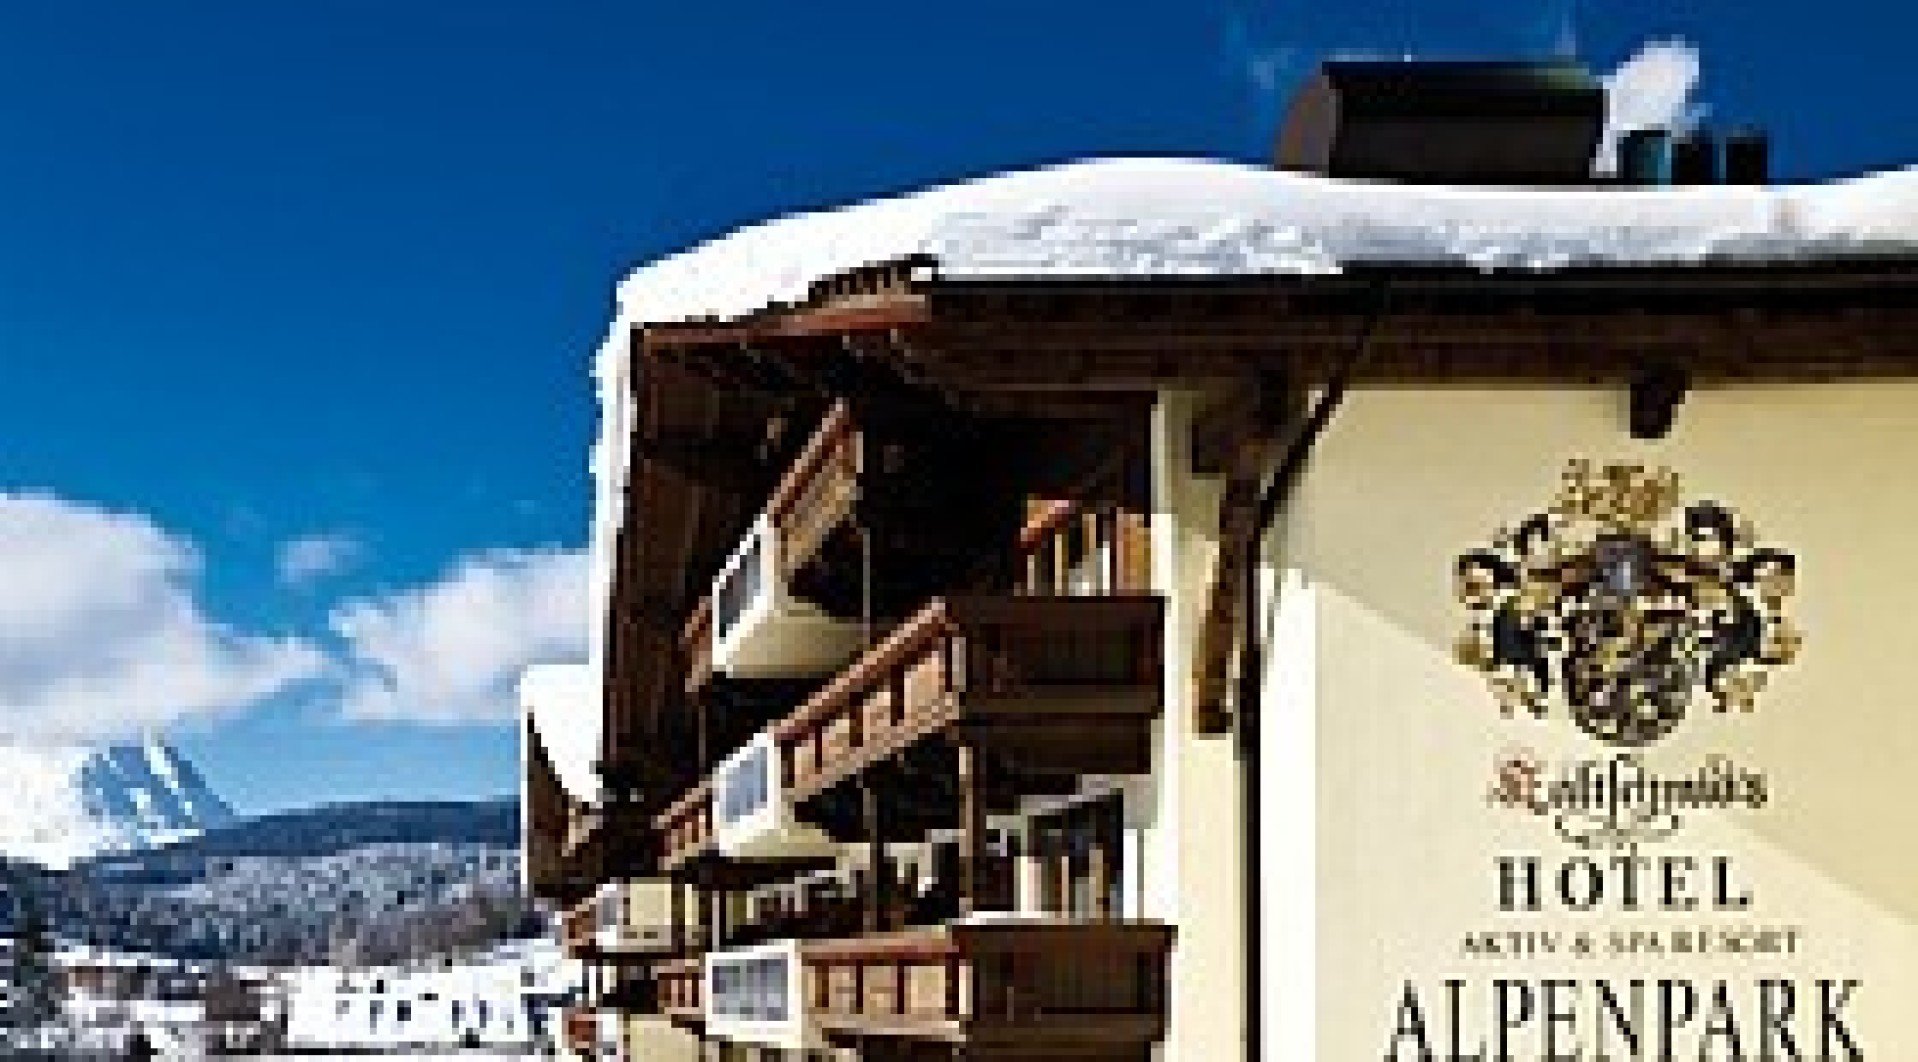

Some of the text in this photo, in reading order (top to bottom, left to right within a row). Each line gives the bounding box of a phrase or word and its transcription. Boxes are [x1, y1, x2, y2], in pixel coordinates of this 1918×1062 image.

[1495, 857, 1753, 911] HOTEL
[1461, 930, 1802, 954] AKTIV & SPA RESORT
[1384, 980, 1864, 1062] ALPENPARK
